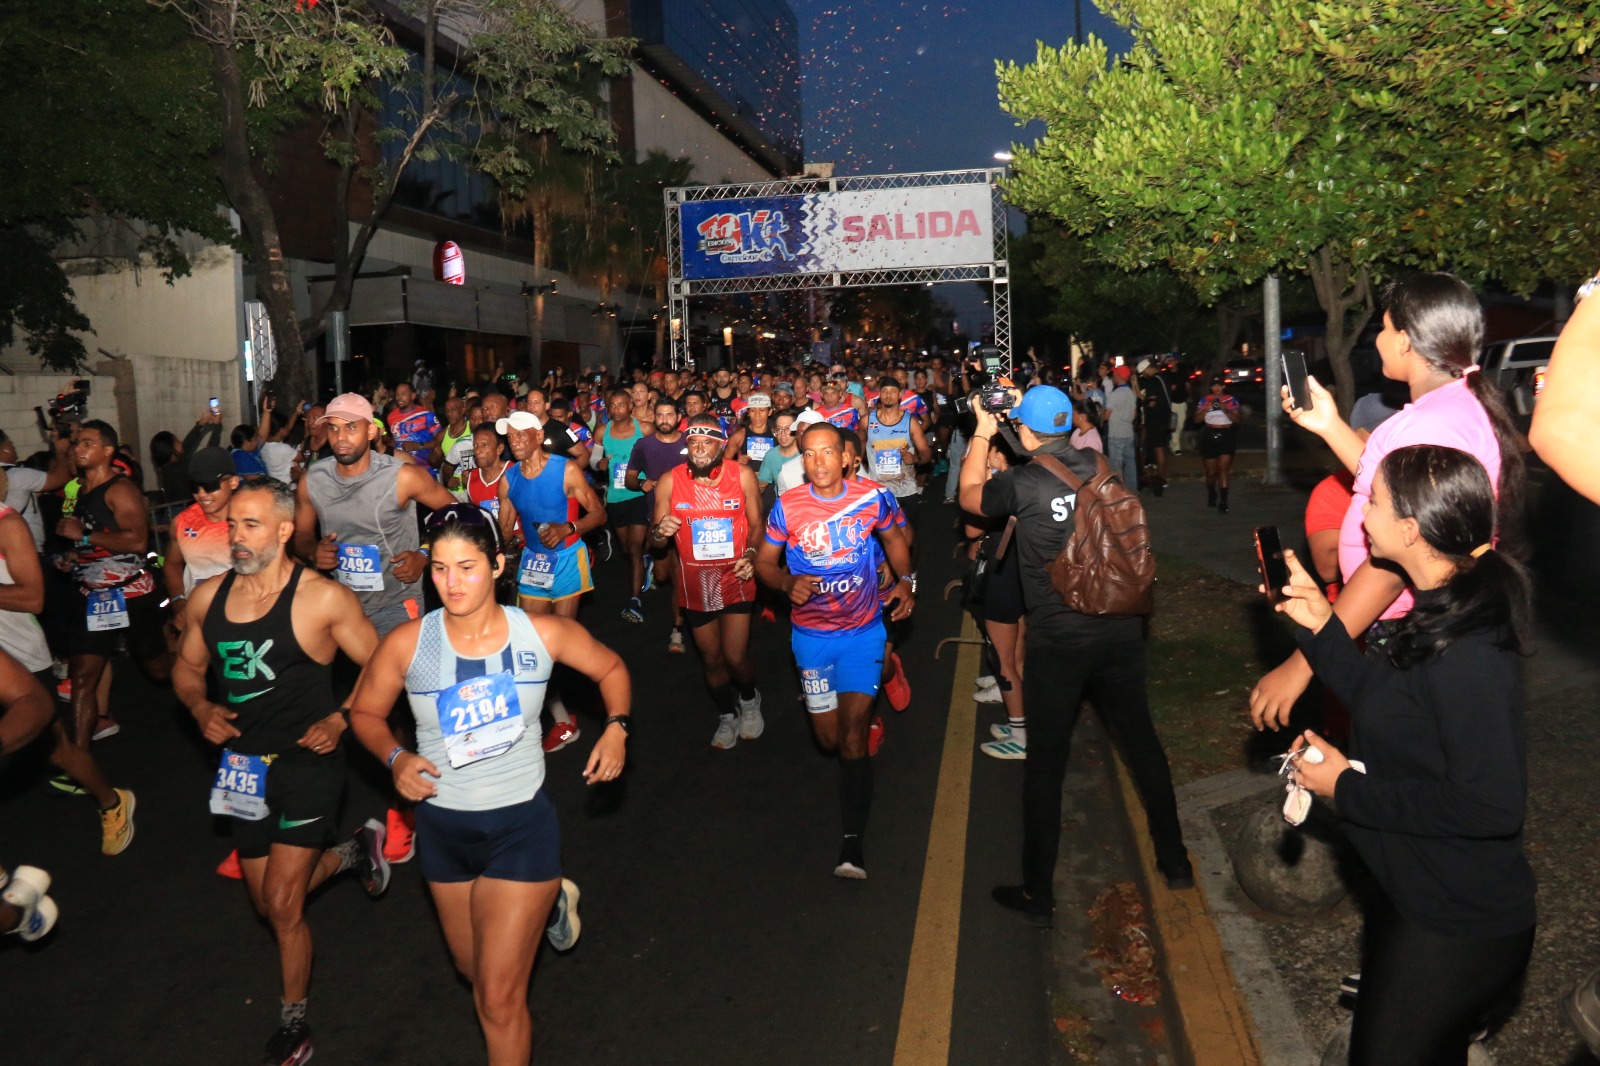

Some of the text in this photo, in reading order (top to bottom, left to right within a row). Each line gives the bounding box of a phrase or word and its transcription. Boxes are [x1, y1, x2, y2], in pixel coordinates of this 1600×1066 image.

[842, 209, 982, 243] SALIDA
[689, 427, 711, 435] NY
[697, 530, 728, 544] 2895
[340, 556, 375, 573] 2492
[525, 558, 552, 573] 1133
[92, 600, 120, 615] 3171
[217, 639, 276, 681] EK
[802, 678, 829, 695] 686
[450, 694, 509, 733] 2194
[217, 768, 259, 795] 3435
